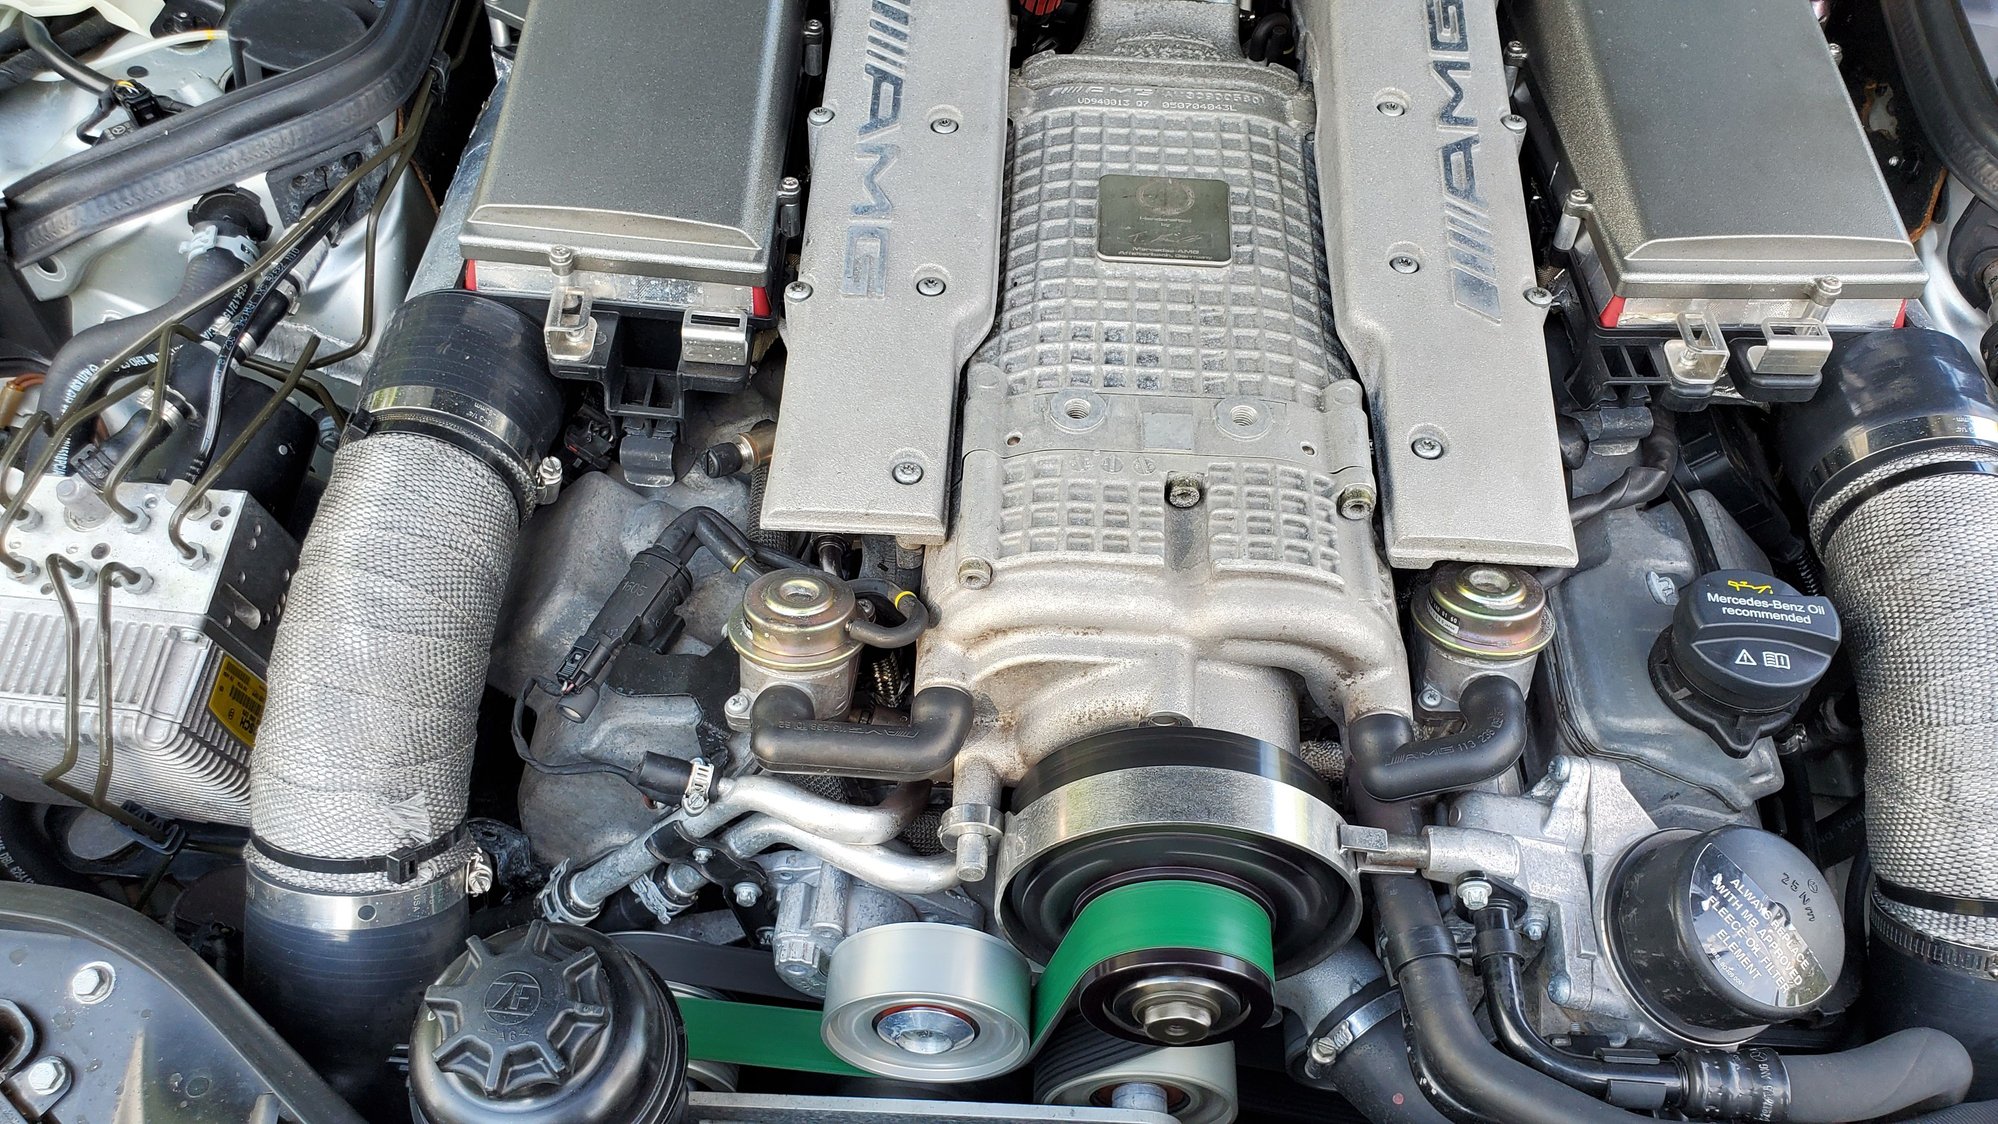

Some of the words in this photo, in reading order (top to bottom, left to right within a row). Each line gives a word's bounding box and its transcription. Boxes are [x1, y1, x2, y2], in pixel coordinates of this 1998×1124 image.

[841, 62, 904, 298] AMG
[1706, 592, 1805, 613] Mercedes-Benz
[1808, 604, 1825, 615] Oil
[1722, 606, 1812, 624] recommended
[1715, 882, 1744, 912] WITH
[1741, 909, 1759, 929] MB
[1757, 928, 1803, 986] APPROVED
[1730, 878, 1773, 920] ALWAYS
[1770, 919, 1810, 971] REPLACE
[1716, 929, 1762, 980] ELEMENT
[1760, 957, 1790, 994] FILTER
